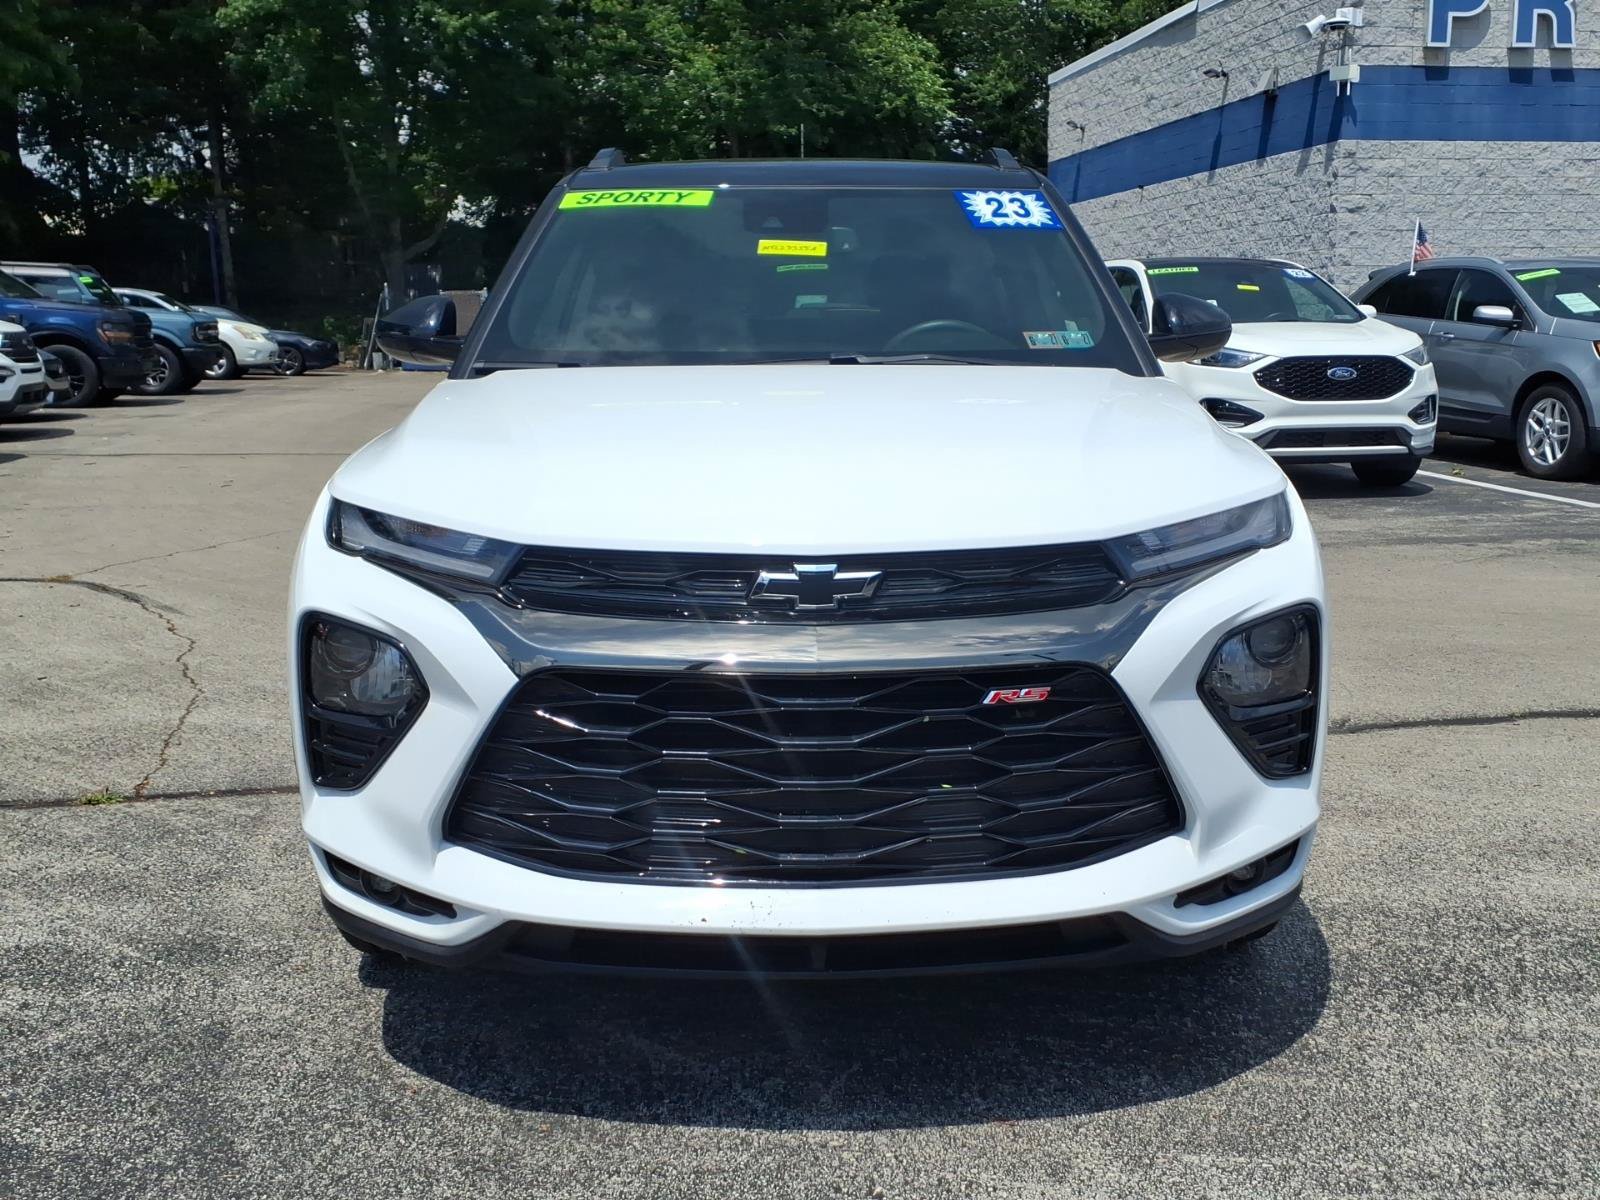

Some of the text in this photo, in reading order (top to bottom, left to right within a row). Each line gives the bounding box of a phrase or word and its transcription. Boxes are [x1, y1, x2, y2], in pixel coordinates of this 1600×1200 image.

[576, 191, 693, 205] SPORTY
[985, 197, 1032, 218] 23
[982, 686, 1052, 704] RS
